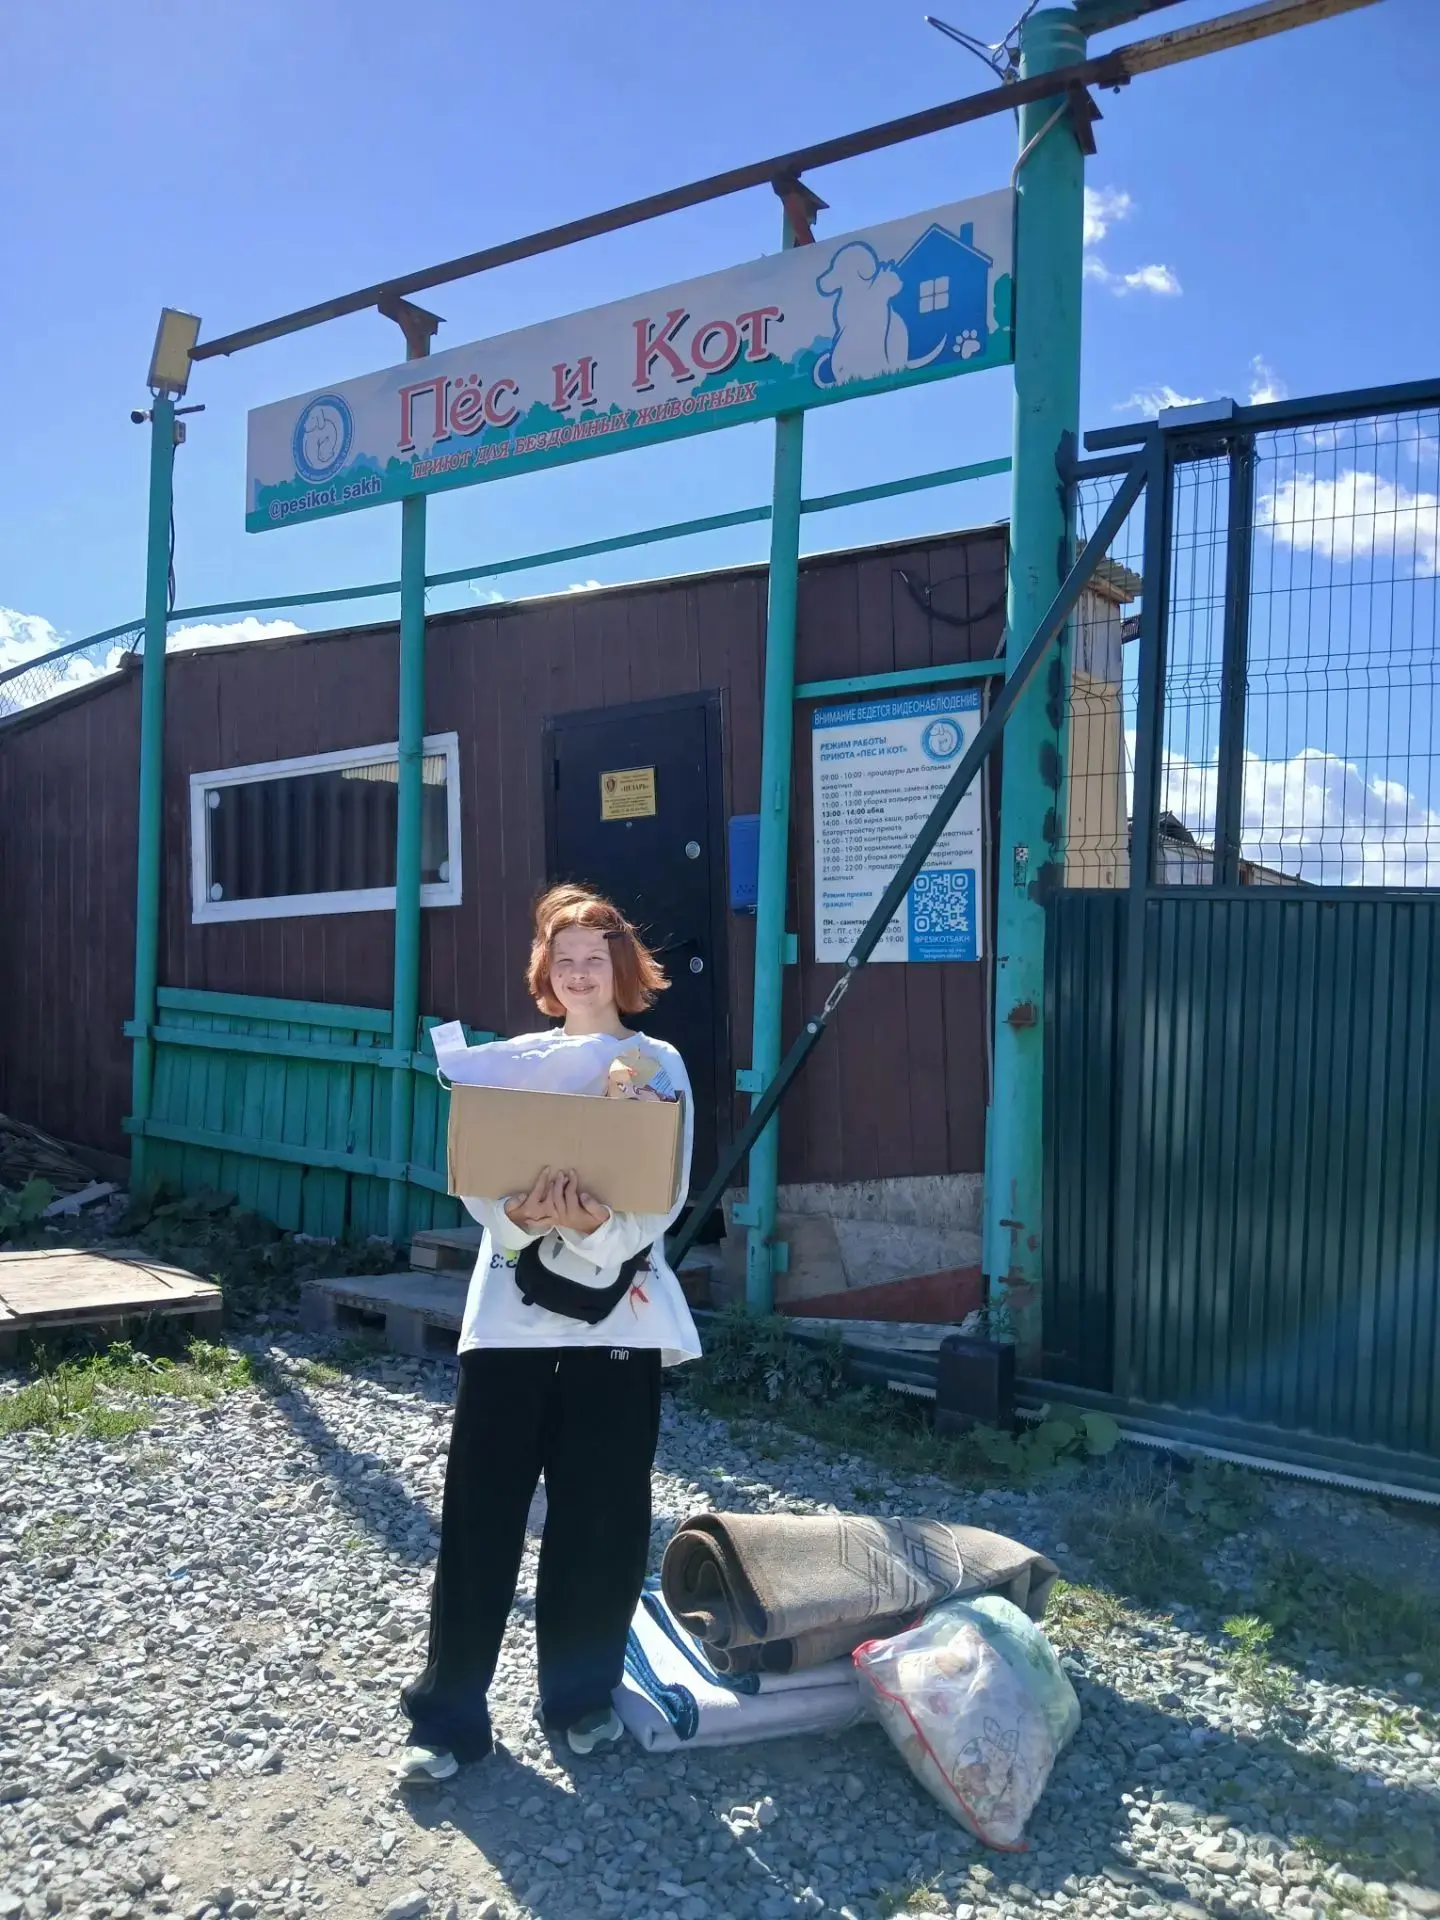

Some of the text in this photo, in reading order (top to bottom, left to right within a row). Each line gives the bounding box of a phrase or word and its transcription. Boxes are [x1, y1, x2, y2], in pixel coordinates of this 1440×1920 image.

[397, 374, 518, 451] Пёс
[552, 356, 596, 411] и
[632, 306, 783, 391] Кот
[412, 381, 758, 479] ПРИЮТ ДЛЯ БЕЗДОМНЫХ ЖИВОТНЫХ
[269, 475, 381, 519] @pesikot_sakh
[814, 693, 978, 725] ВНИМАНИЕ ВЕДЕТСЯ ВИДЕОНАБЛЮДЕНИЕ
[820, 736, 887, 752] РЕЖИМ РАБОТЫ
[820, 752, 856, 762] ПРИЮТА
[822, 810, 841, 818] 13:00
[610, 1349, 630, 1361] min
